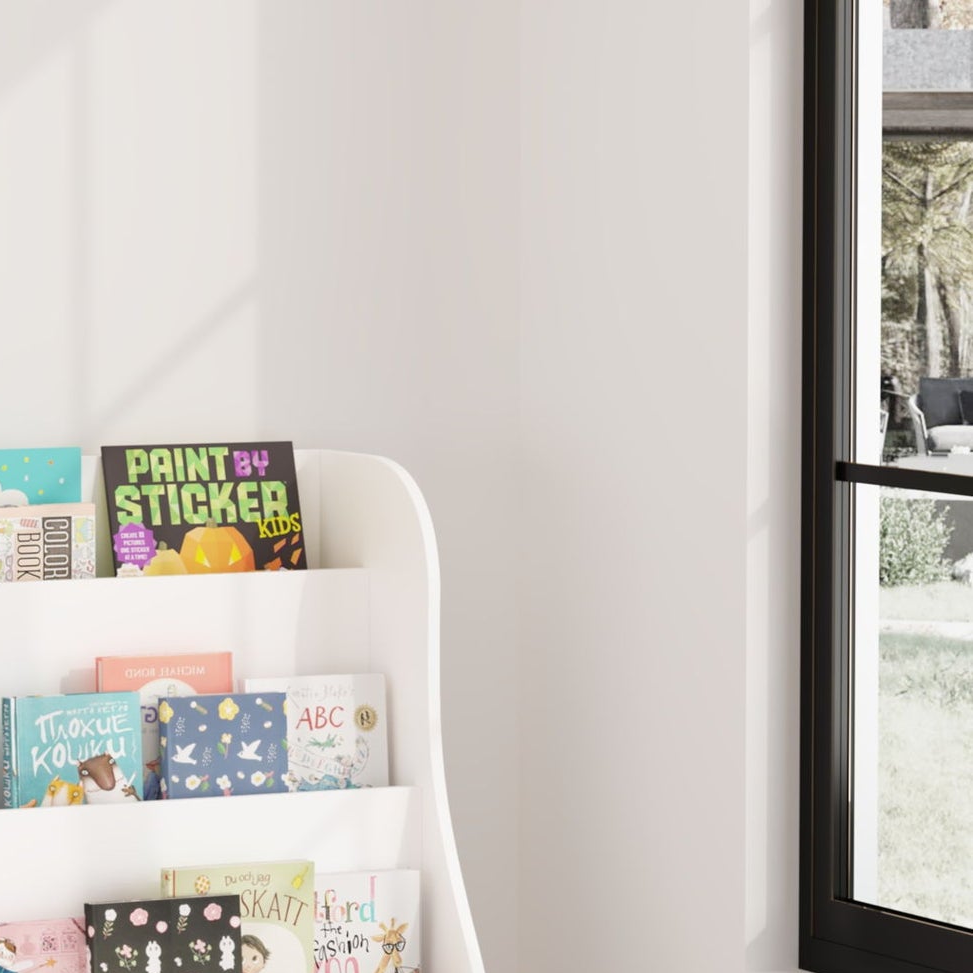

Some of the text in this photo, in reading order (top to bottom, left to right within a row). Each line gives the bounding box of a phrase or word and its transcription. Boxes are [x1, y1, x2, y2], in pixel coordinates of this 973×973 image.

[125, 446, 269, 483] PAINT BY
[114, 480, 290, 526] STICKER
[256, 512, 301, 539] KIDS
[17, 532, 41, 580] BOOK
[296, 706, 345, 731] ABC
[224, 875, 237, 887] Du
[240, 889, 309, 926] SKATT
